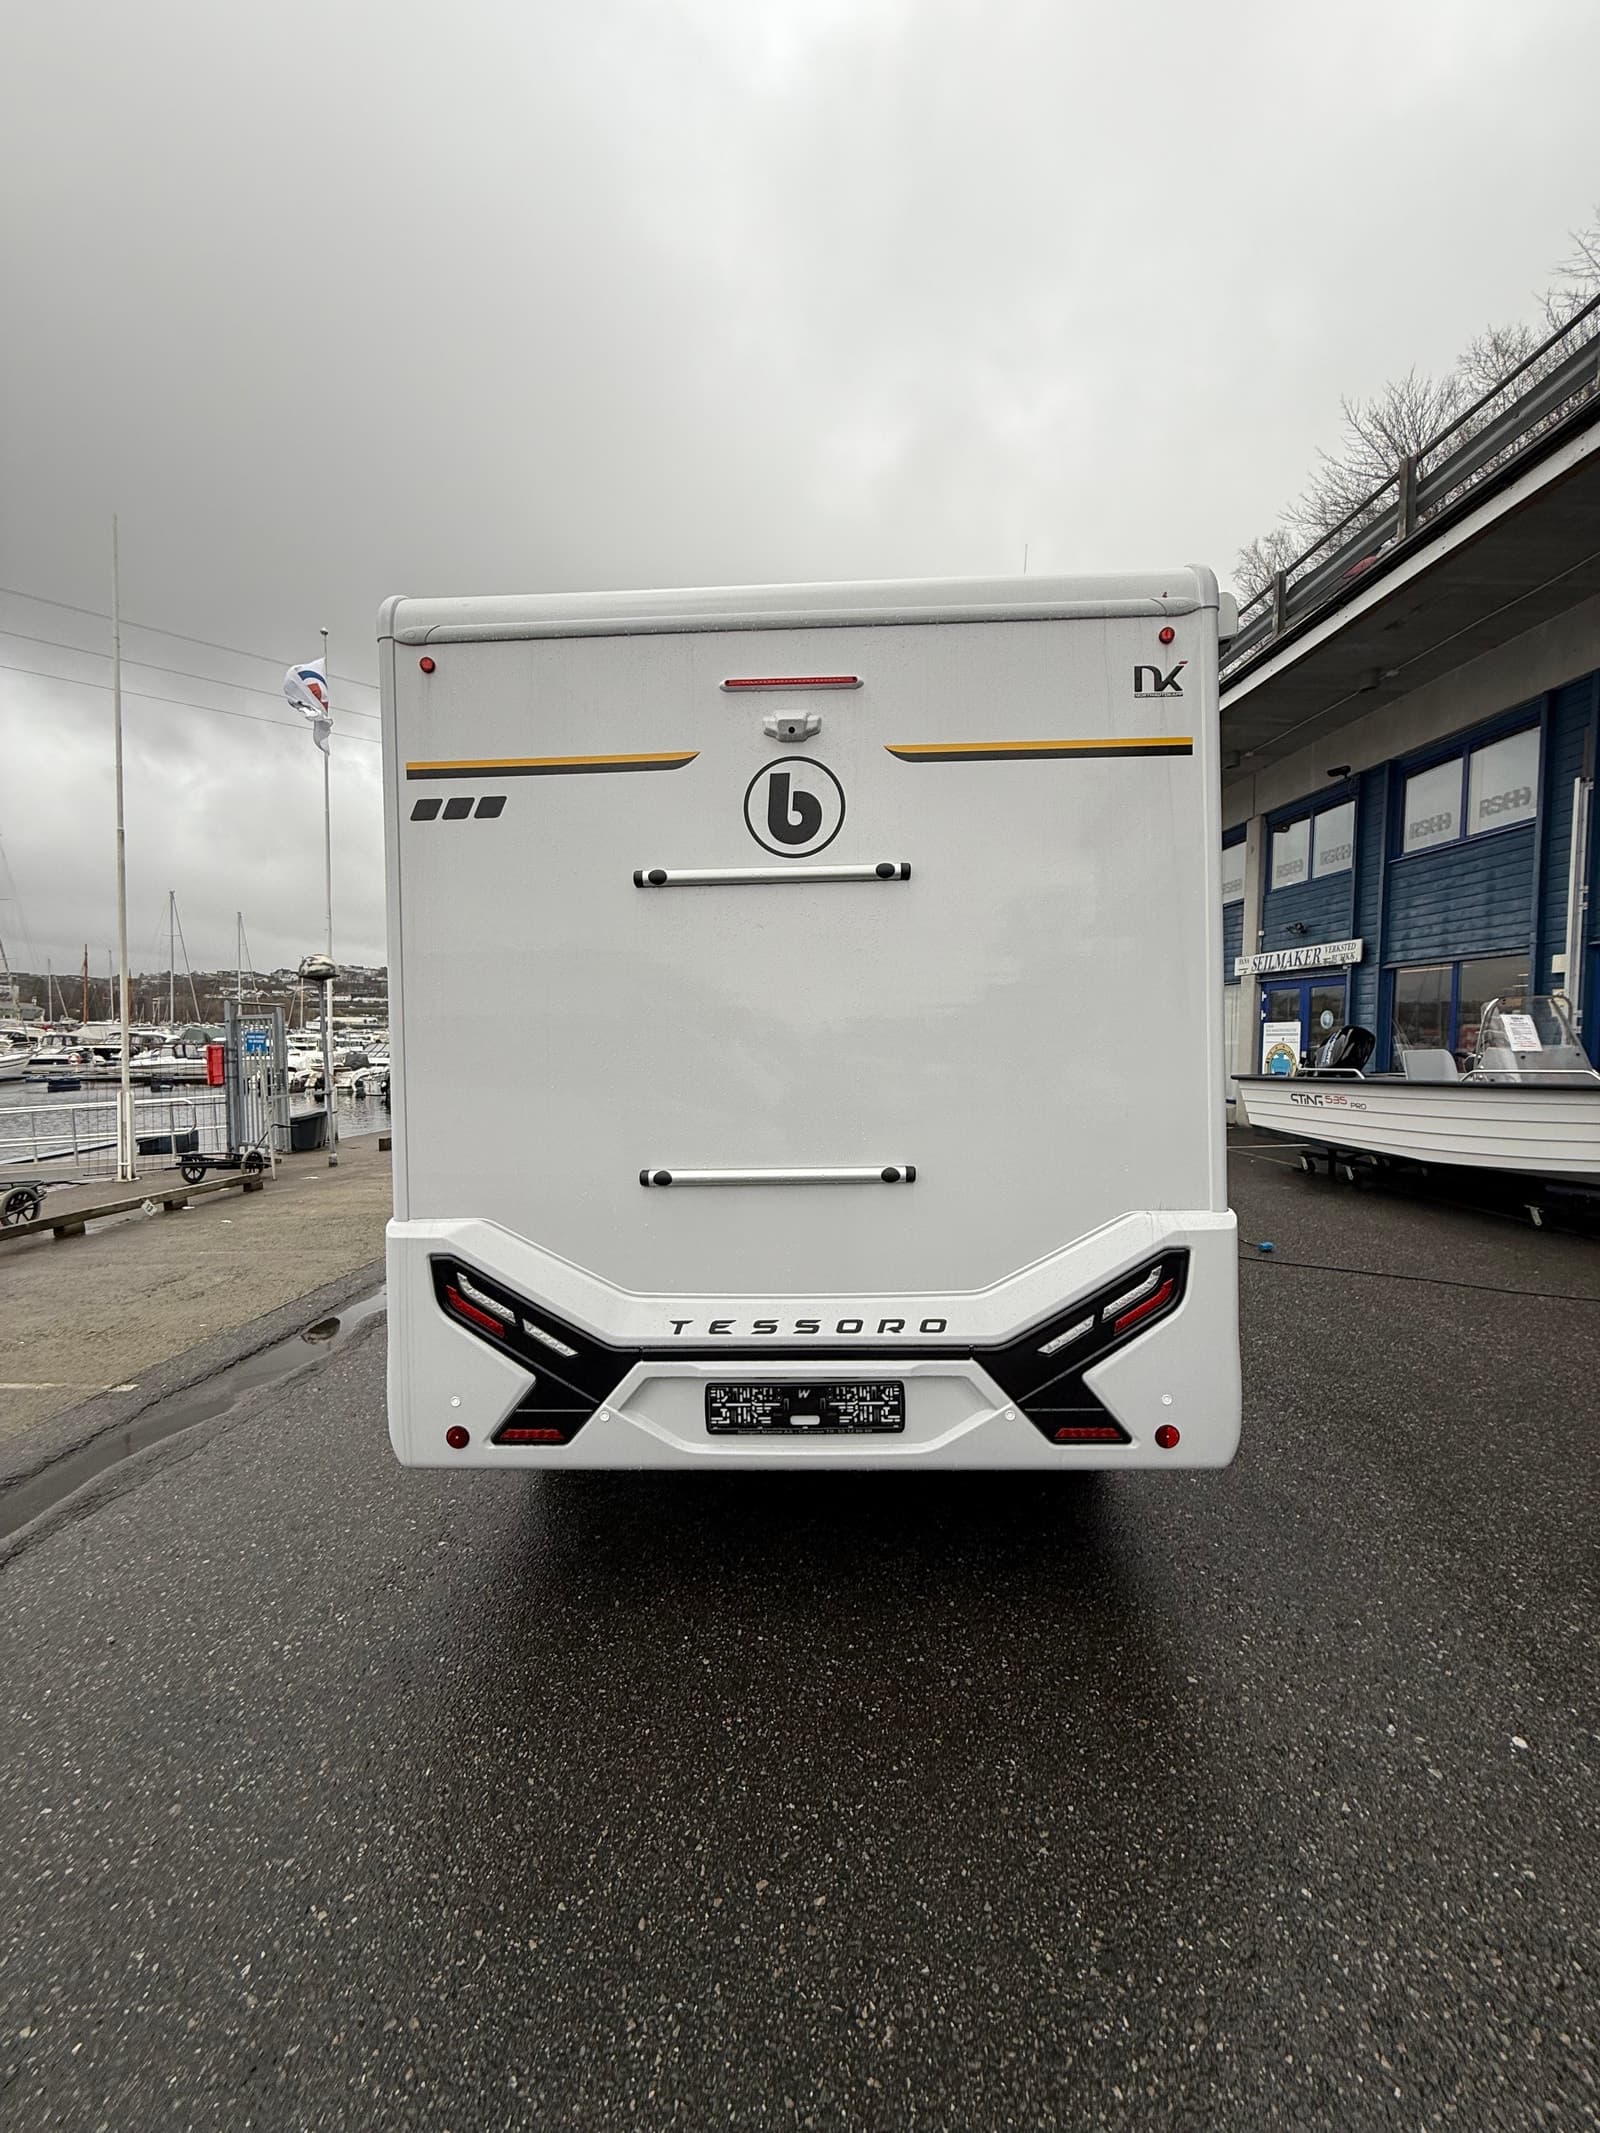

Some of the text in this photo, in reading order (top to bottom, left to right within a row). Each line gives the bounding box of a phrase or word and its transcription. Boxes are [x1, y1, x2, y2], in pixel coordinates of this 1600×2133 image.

[1252, 947, 1321, 972] SEILMAKER
[1325, 942, 1357, 954] VERKSTED
[1324, 1095, 1348, 1105] 535
[1350, 1102, 1367, 1110] PRO
[669, 1318, 947, 1335] TESSORO
